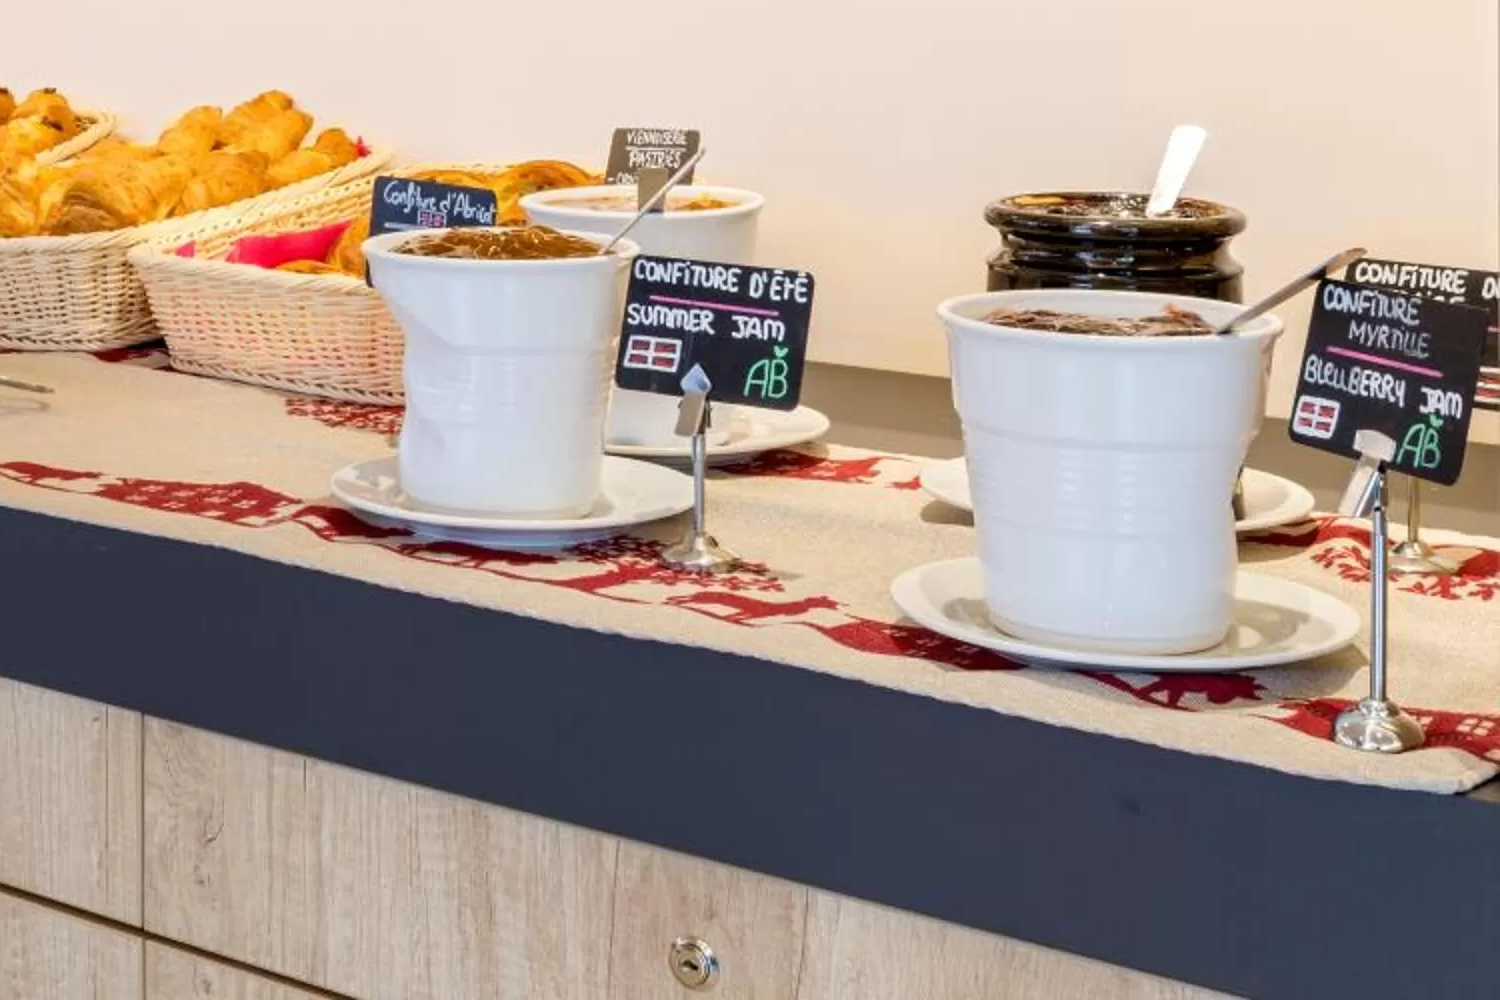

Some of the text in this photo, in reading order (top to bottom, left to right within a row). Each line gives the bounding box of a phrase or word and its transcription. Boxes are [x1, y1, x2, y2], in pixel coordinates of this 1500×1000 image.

[626, 303, 787, 343] SUMMER JAM
[1419, 386, 1464, 420] JAM
